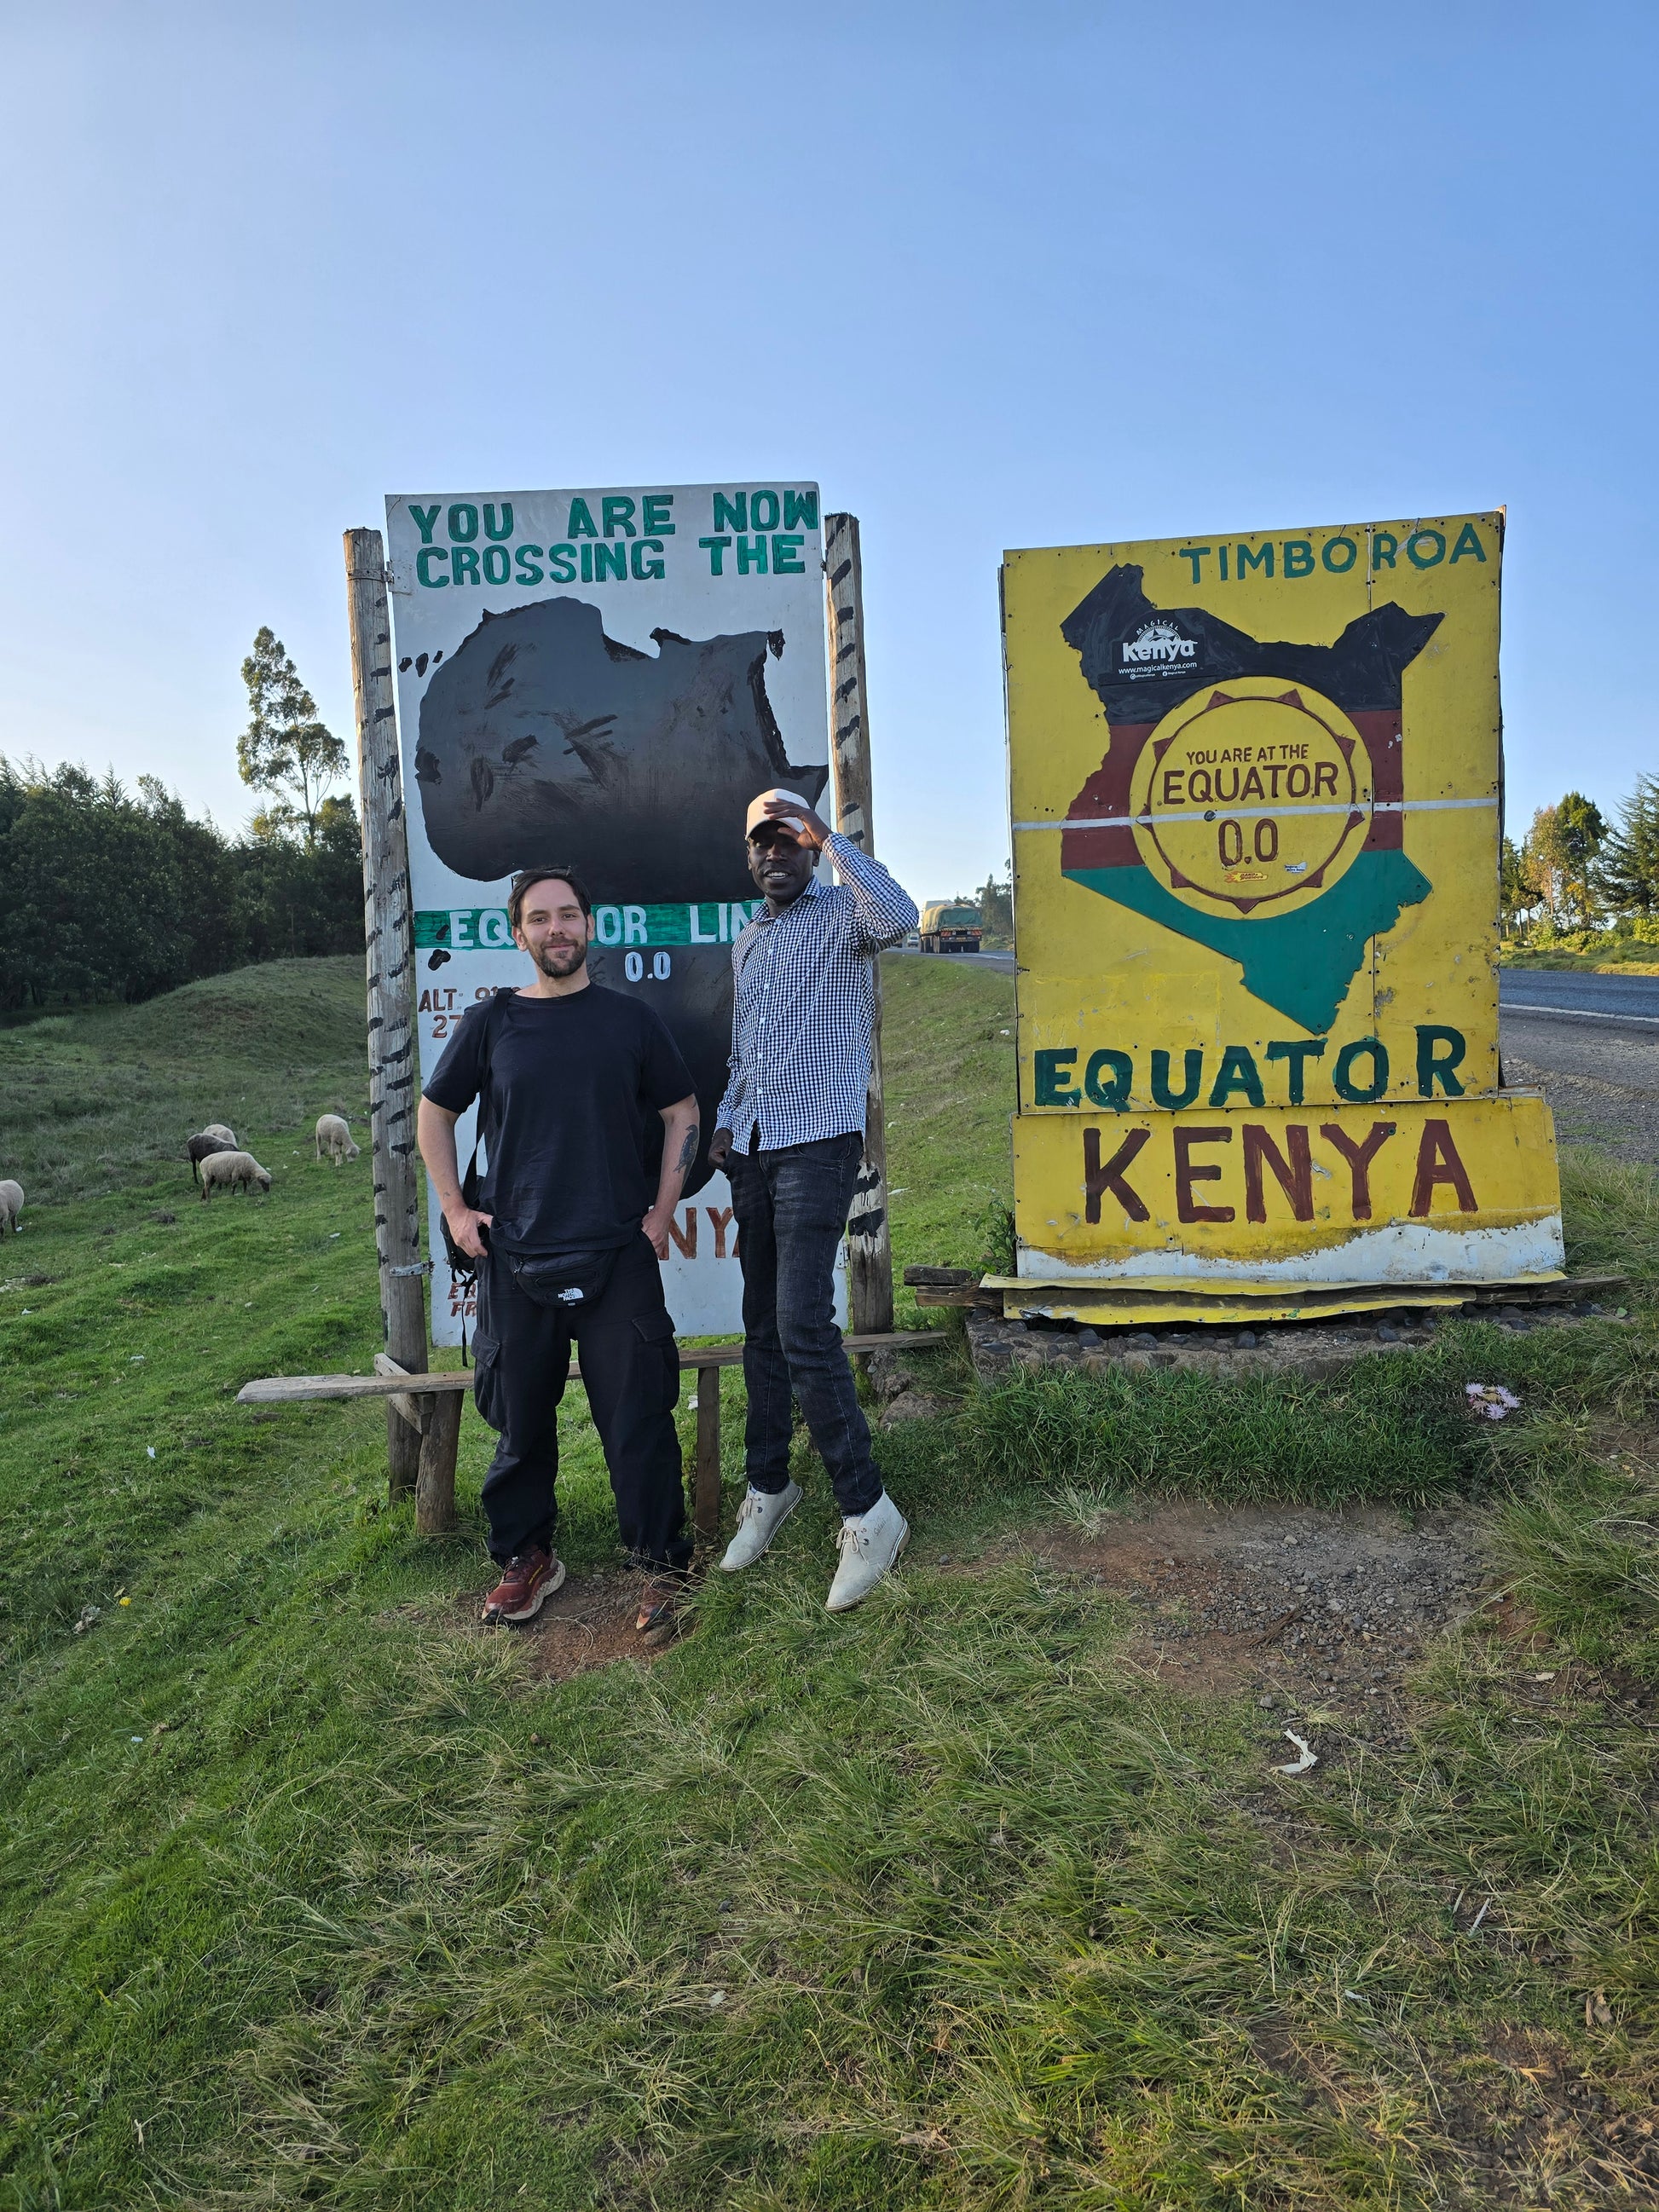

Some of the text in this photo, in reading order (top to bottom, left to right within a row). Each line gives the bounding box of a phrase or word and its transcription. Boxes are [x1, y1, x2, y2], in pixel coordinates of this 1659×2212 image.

[408, 490, 818, 543] YOU ARE NOW
[416, 534, 806, 588] CROSSING THE
[1136, 619, 1179, 635] MAGICAL
[1118, 661, 1198, 674] www.magicalkenya.com
[1122, 639, 1198, 662] Kenya
[1186, 743, 1309, 765] YOU ARE AT THE
[1163, 761, 1339, 805] EQUATOR
[1217, 817, 1279, 867] 0.0
[624, 951, 671, 982] 0.0
[1034, 1025, 1465, 1112] EQUATOR
[1083, 1118, 1478, 1224] KENYA
